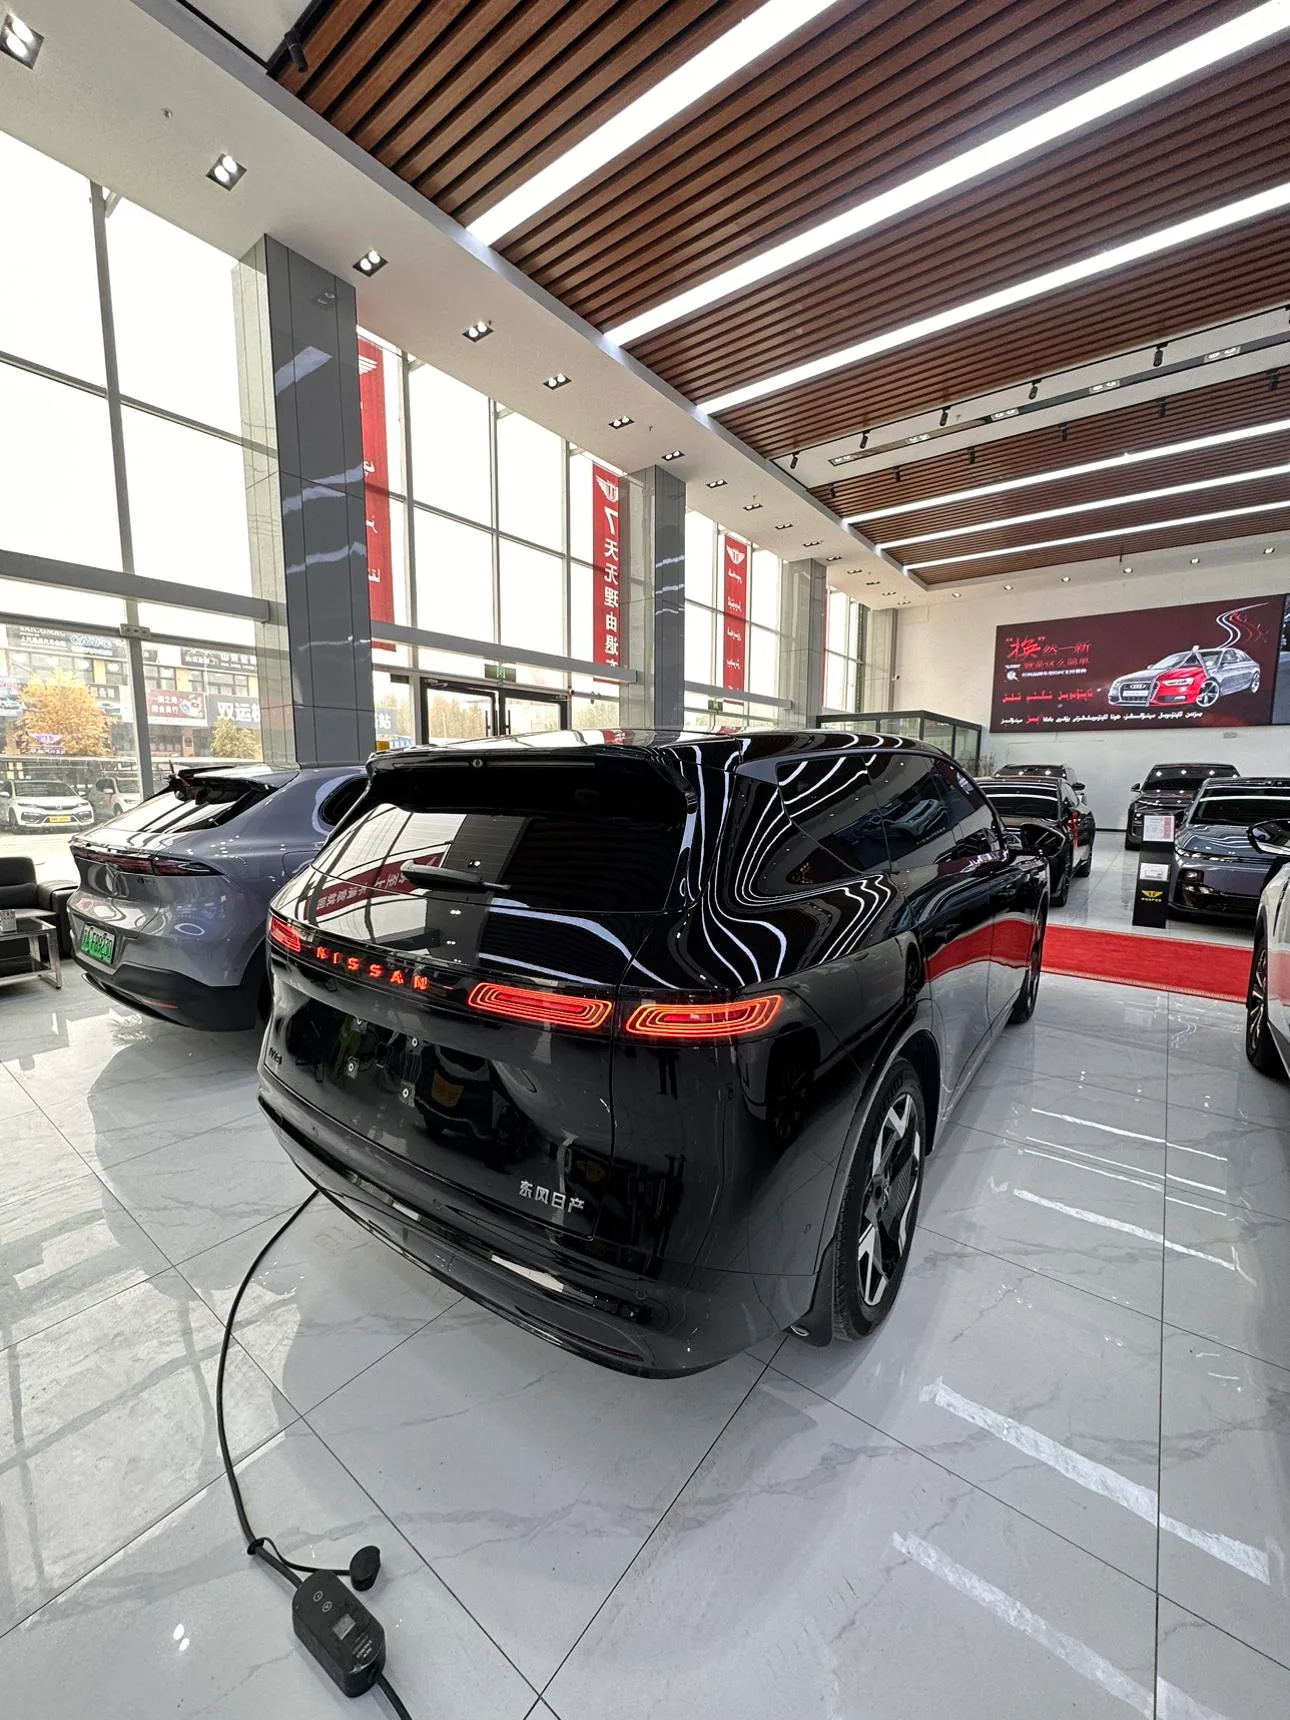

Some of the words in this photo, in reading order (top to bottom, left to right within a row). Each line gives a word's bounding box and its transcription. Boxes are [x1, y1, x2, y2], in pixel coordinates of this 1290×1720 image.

[316, 946, 429, 990] NISSAN
[519, 1180, 585, 1213] 东风日产
